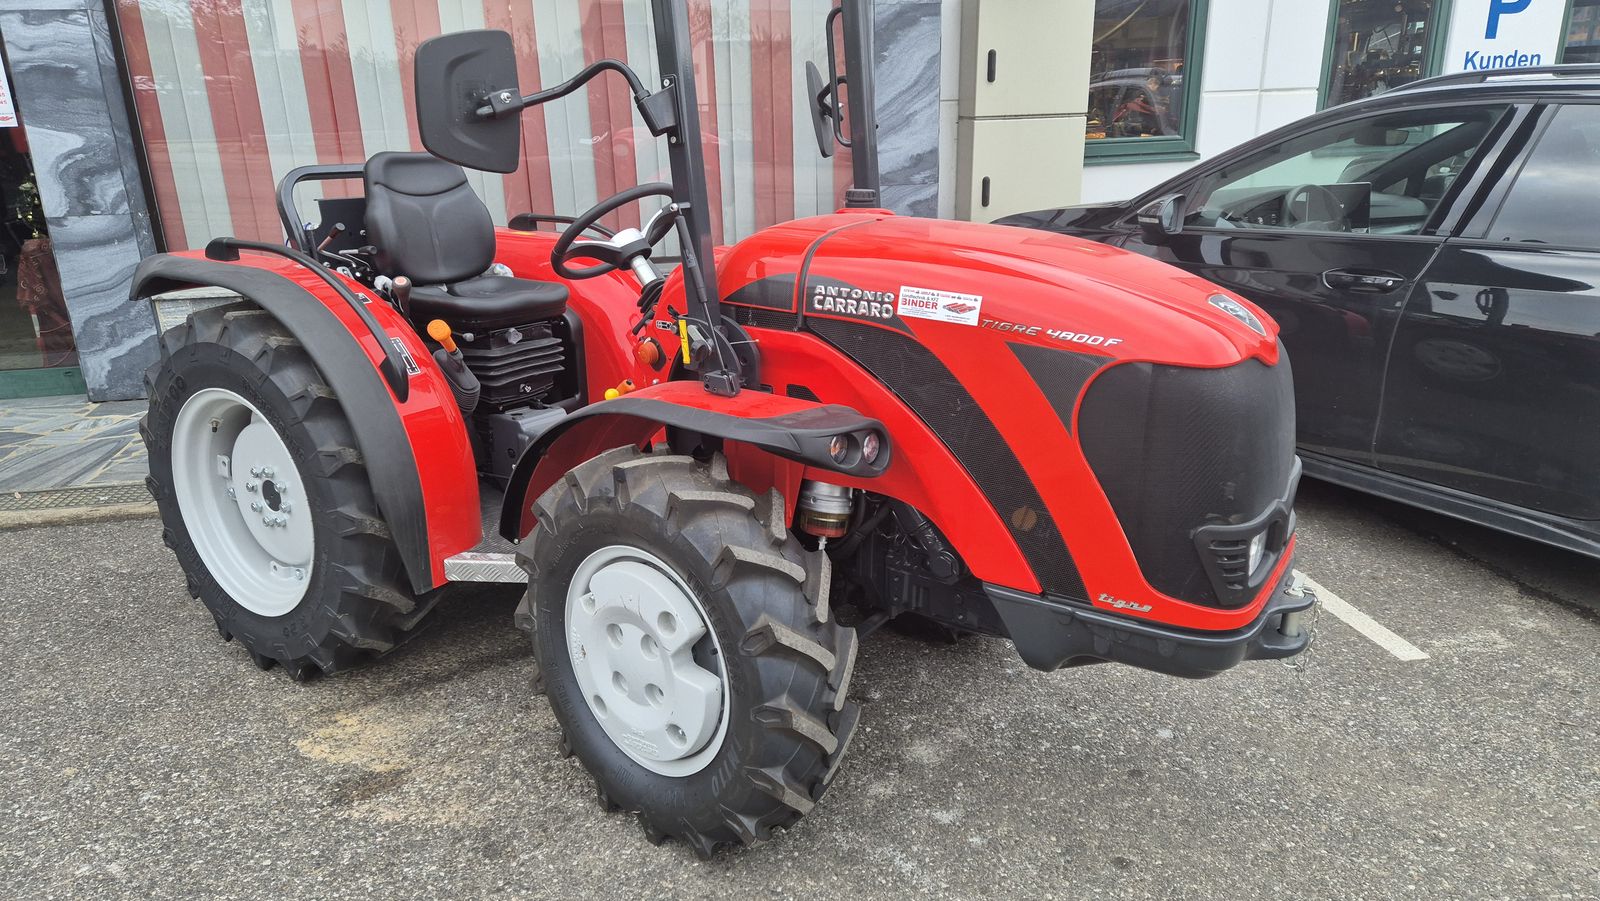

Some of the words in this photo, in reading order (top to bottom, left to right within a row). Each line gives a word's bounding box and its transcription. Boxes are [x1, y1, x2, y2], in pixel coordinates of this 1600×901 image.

[1485, 0, 1532, 39] P
[1463, 49, 1541, 70] Kunden
[814, 285, 895, 303] ANTONIO
[901, 297, 938, 310] BINDER
[813, 295, 894, 319] CARRARO
[981, 319, 1042, 336] TIGRE
